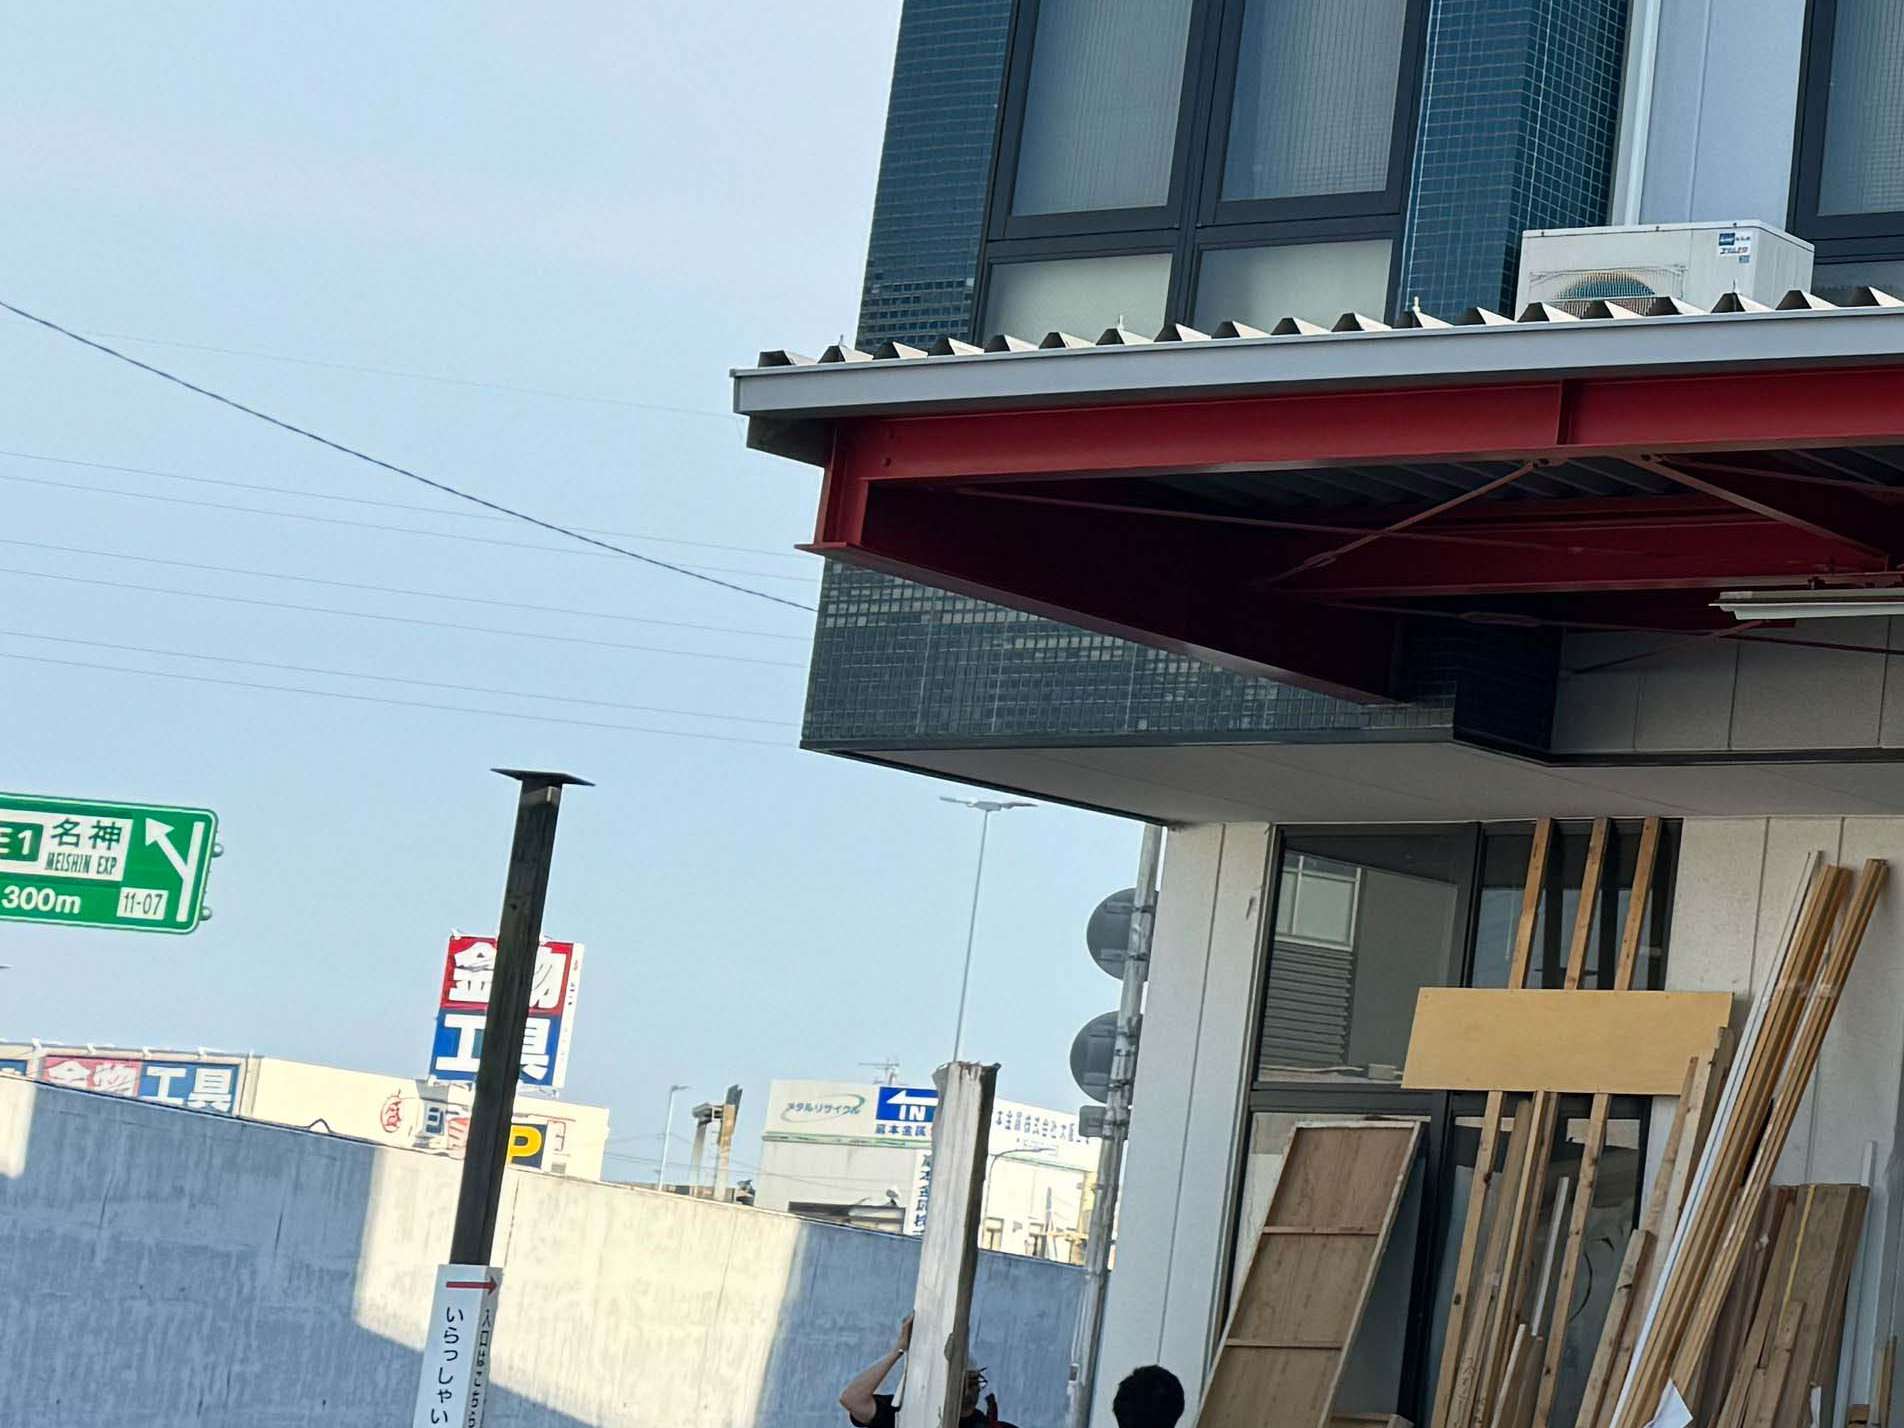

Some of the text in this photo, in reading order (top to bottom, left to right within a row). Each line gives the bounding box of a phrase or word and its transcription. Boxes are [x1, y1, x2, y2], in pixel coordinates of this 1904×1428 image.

[50, 818, 123, 851] 名神
[45, 852, 118, 875] MEISHIN EXP
[2, 885, 82, 914] 300m
[123, 891, 164, 916] 11-07
[898, 1104, 926, 1121] IN
